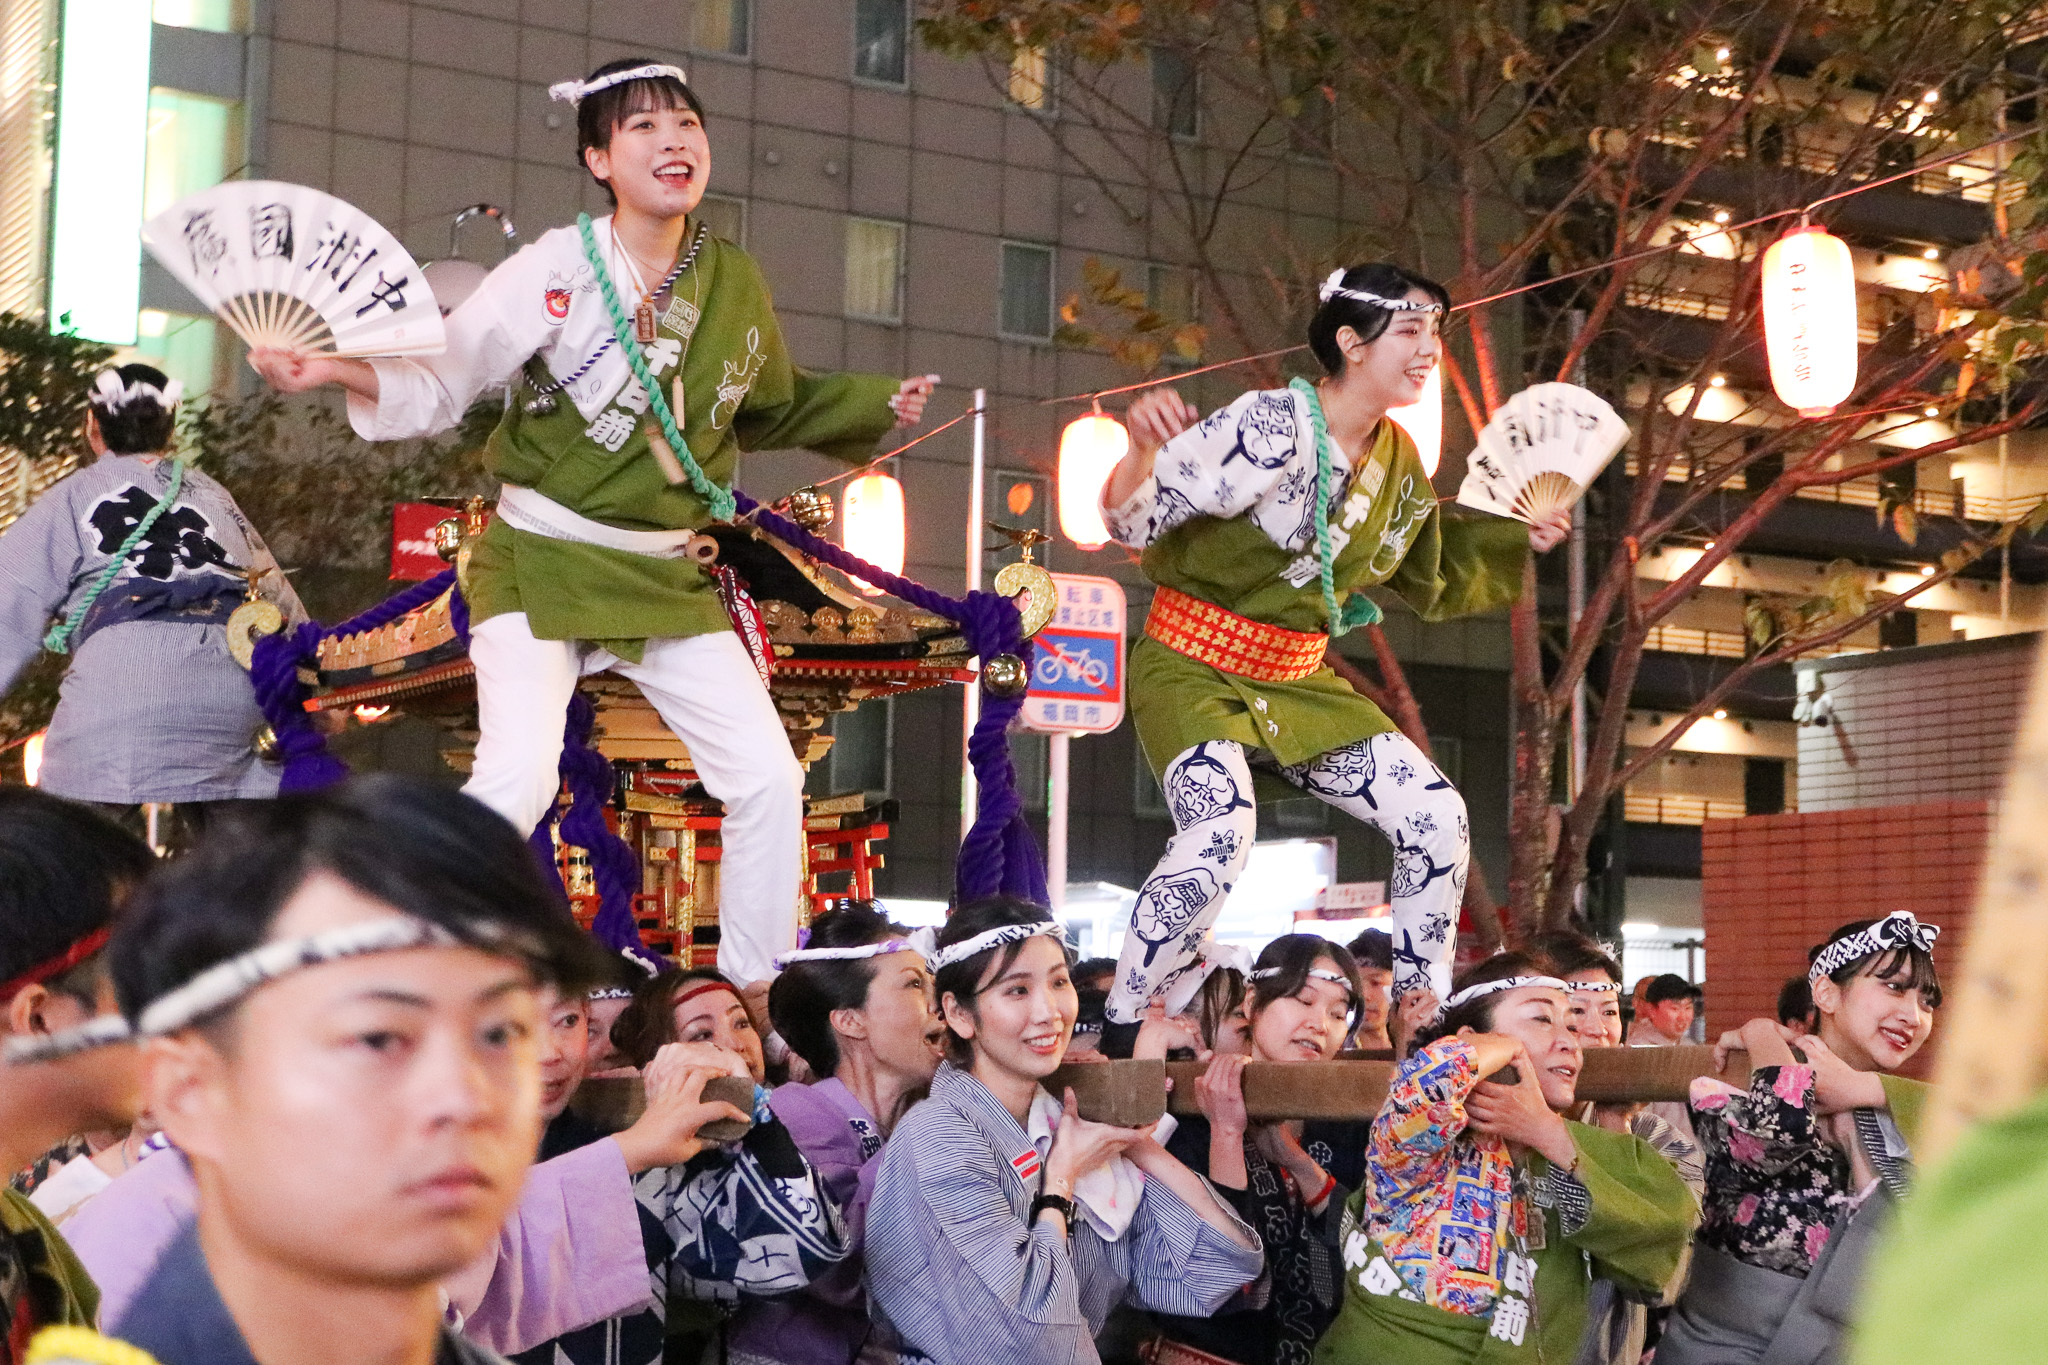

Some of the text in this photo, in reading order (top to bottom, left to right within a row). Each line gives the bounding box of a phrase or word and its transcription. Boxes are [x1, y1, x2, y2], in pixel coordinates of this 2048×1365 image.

[585, 337, 682, 452] 千日前
[1052, 607, 1114, 627] 禁止区域
[1066, 586, 1104, 604] 転車
[1344, 1230, 1421, 1302] 千日
[1490, 1251, 1538, 1346] 日前
